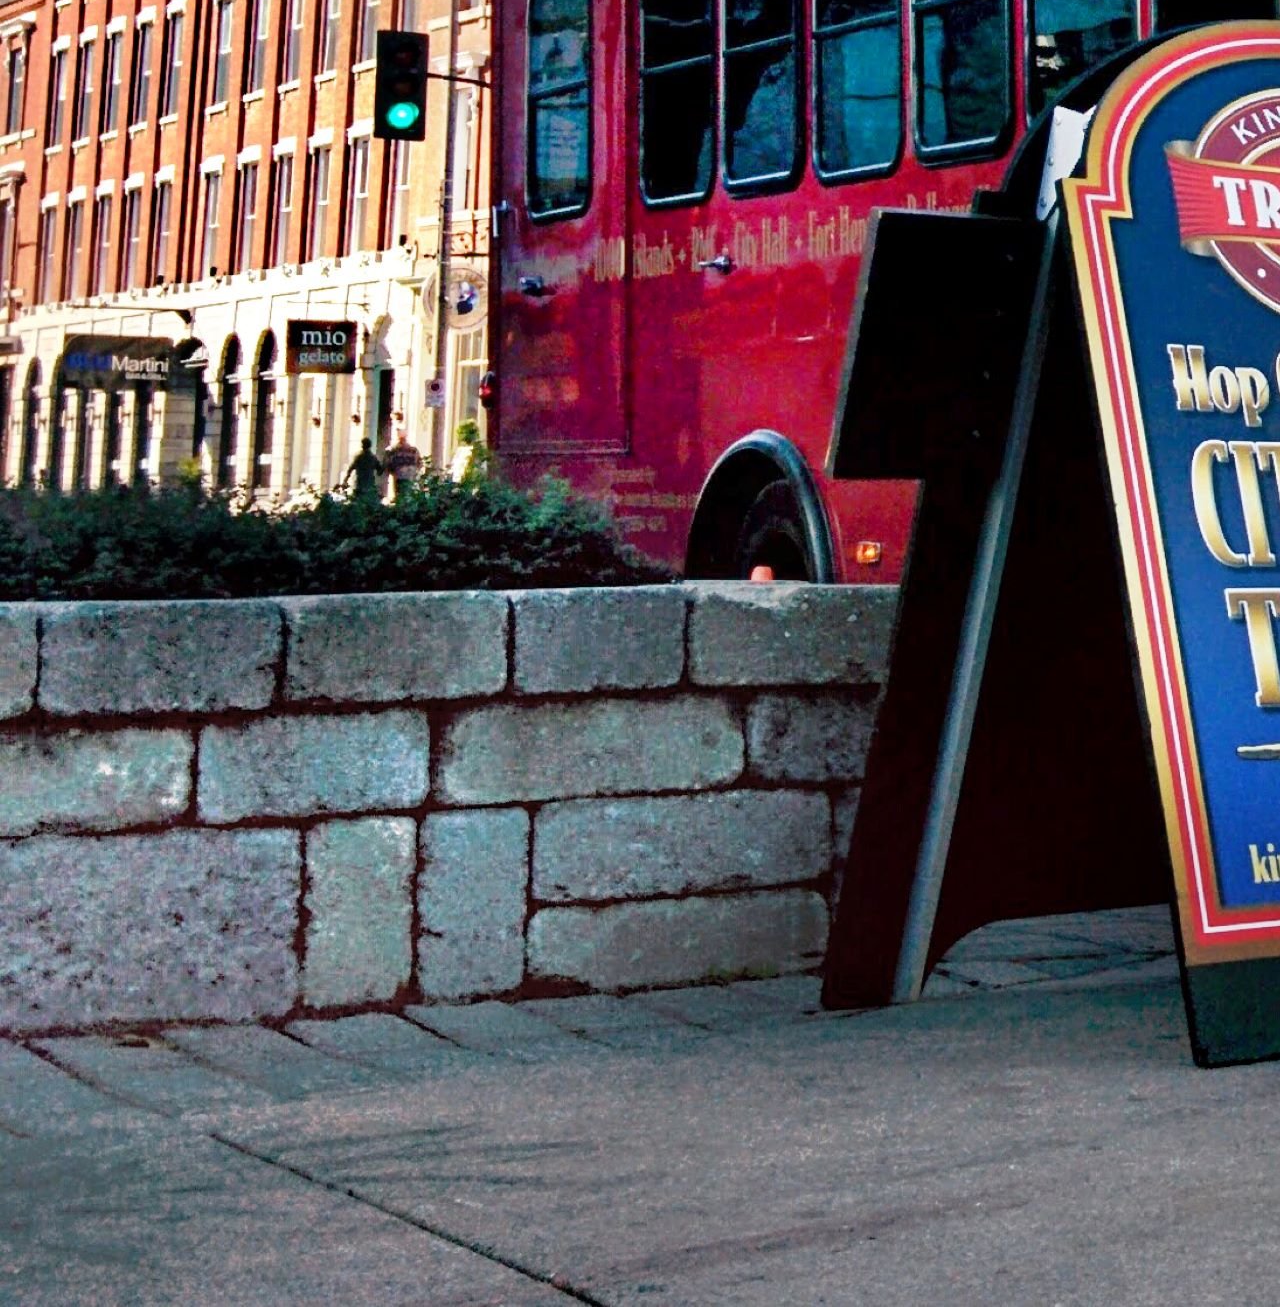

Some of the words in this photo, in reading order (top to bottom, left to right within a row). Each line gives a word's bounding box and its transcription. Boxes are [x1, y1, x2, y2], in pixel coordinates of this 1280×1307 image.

[762, 215, 788, 266] Hall
[808, 210, 834, 260] Fort
[301, 326, 347, 345] mio
[299, 349, 346, 367] gelato
[1167, 344, 1269, 427] Hop
